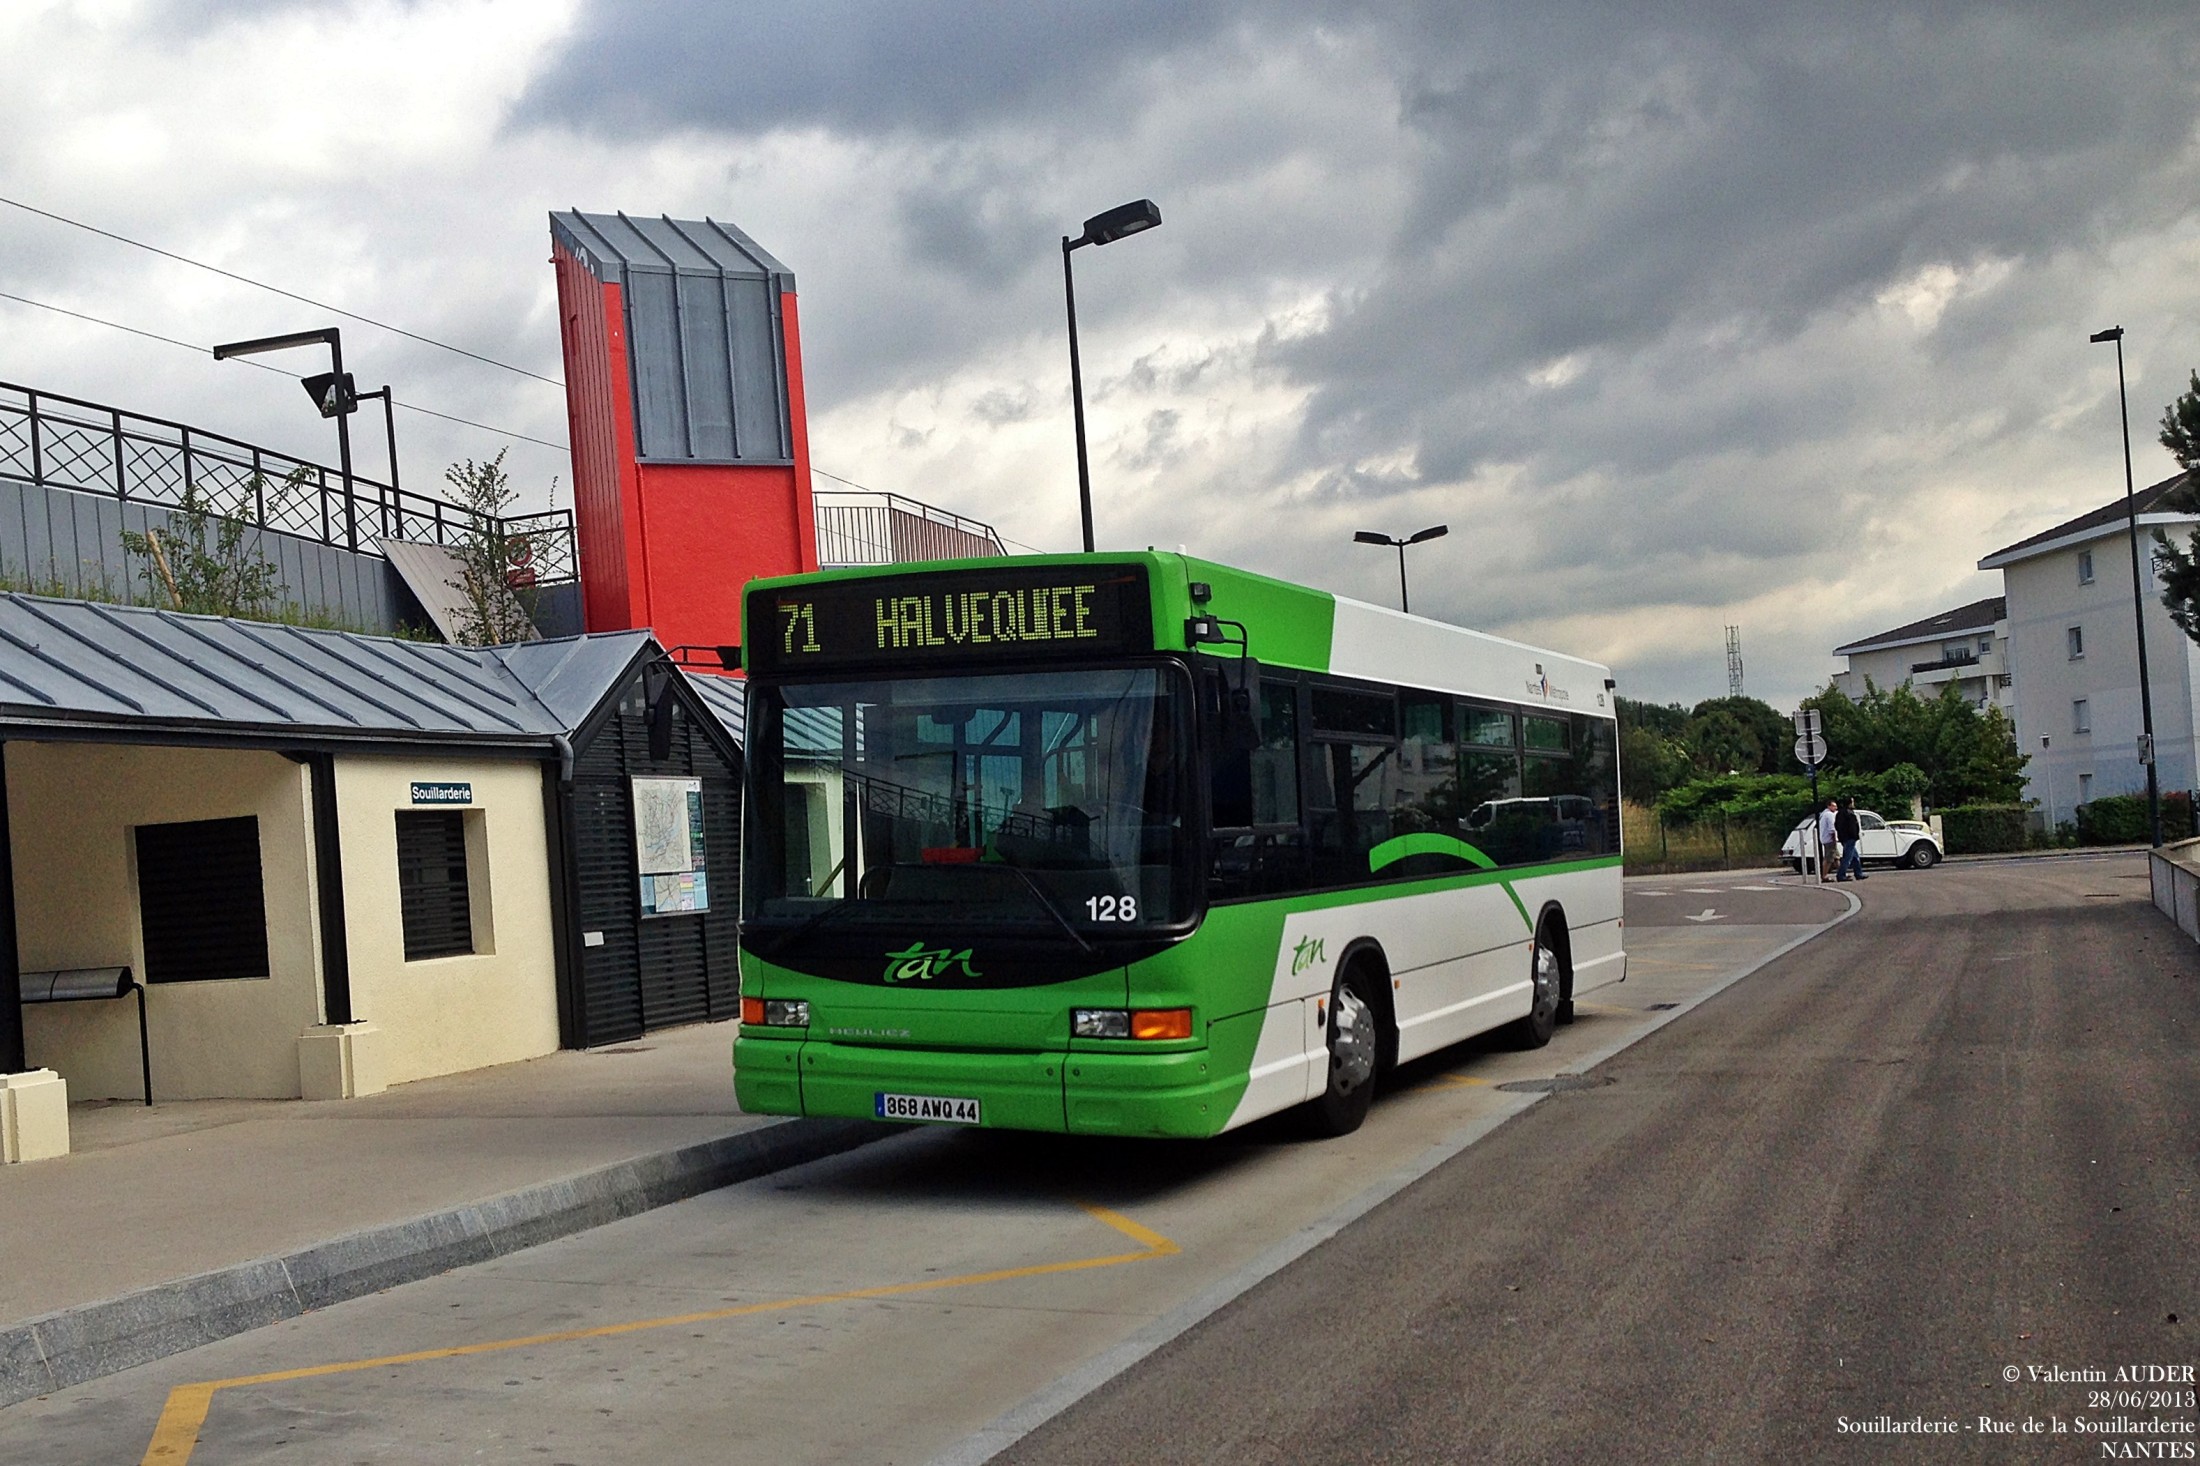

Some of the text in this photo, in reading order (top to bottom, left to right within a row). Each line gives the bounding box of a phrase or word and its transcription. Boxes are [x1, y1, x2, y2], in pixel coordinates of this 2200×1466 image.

[778, 603, 821, 653] 71
[412, 786, 471, 800] Souillarderie
[1085, 895, 1137, 921] 128
[883, 942, 983, 983] tan
[1292, 935, 1327, 976] tan
[886, 1096, 976, 1121] 368 AWQ 44
